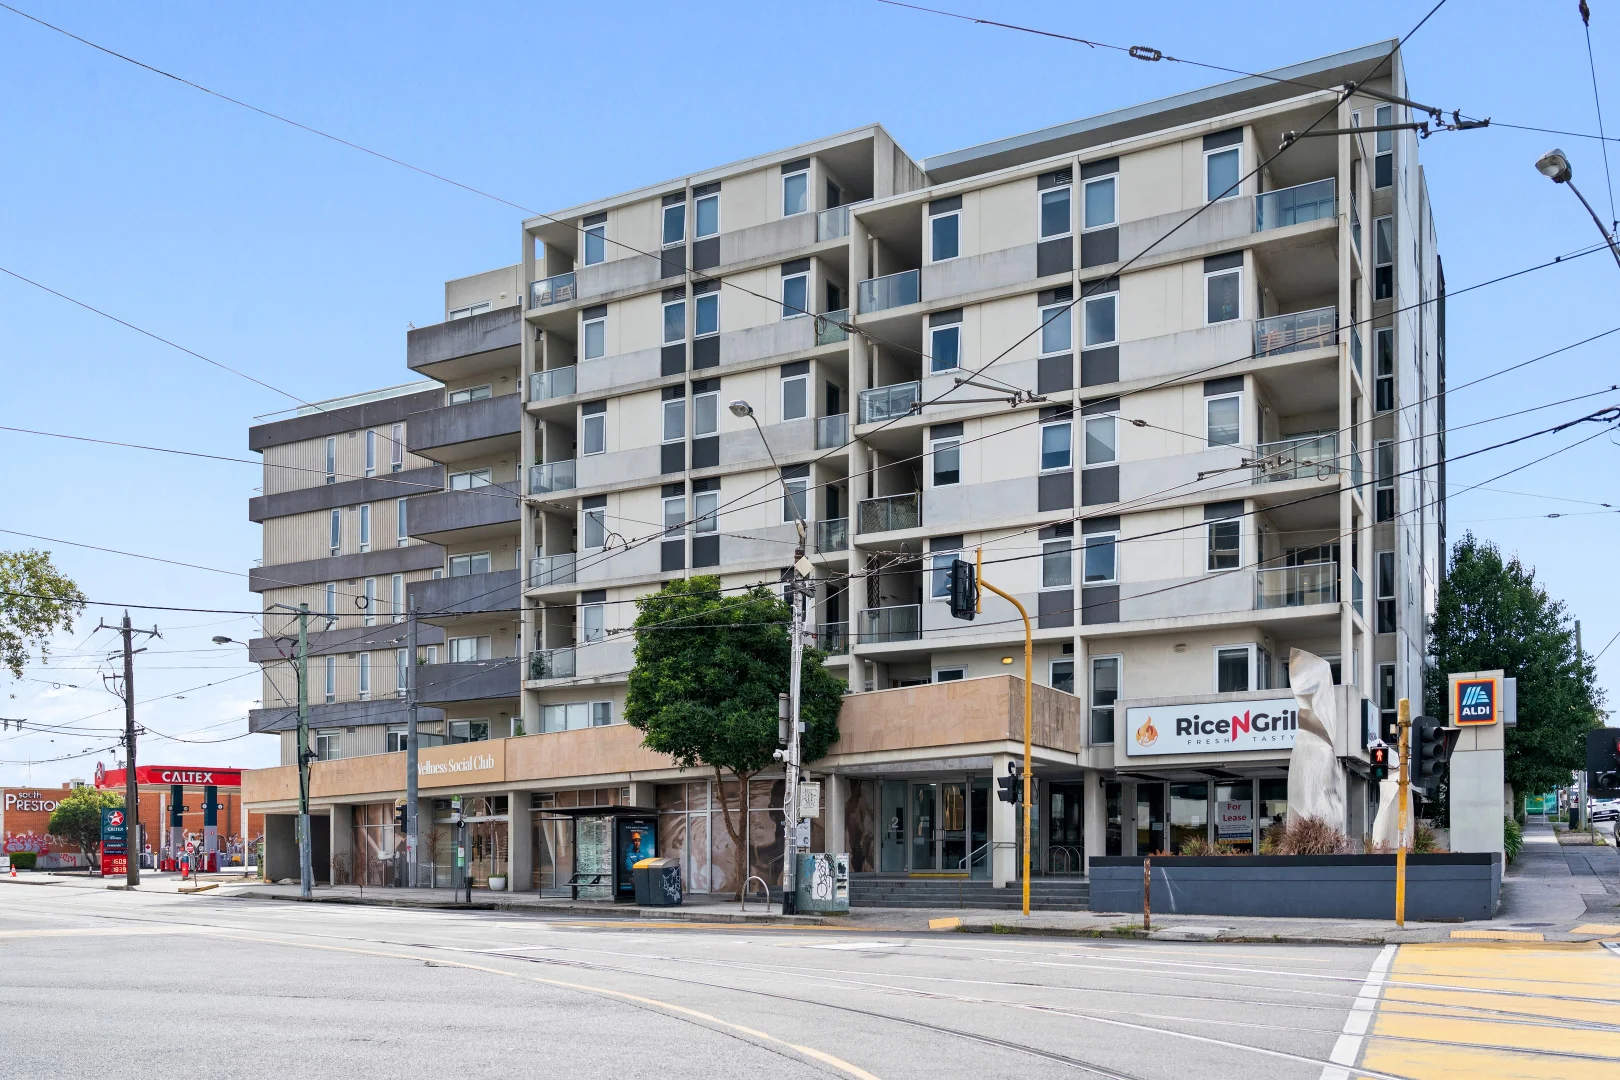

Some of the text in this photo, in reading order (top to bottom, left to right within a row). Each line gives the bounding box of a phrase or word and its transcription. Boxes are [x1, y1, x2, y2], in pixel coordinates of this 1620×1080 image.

[1462, 706, 1490, 715] ALDI
[1176, 710, 1296, 742] RiceNGril
[1187, 734, 1295, 746] FRESH TASTY
[448, 756, 472, 772] Social
[473, 754, 495, 771] Club
[162, 771, 213, 783] CALTEX
[18, 791, 42, 799] south
[891, 816, 899, 828] 2
